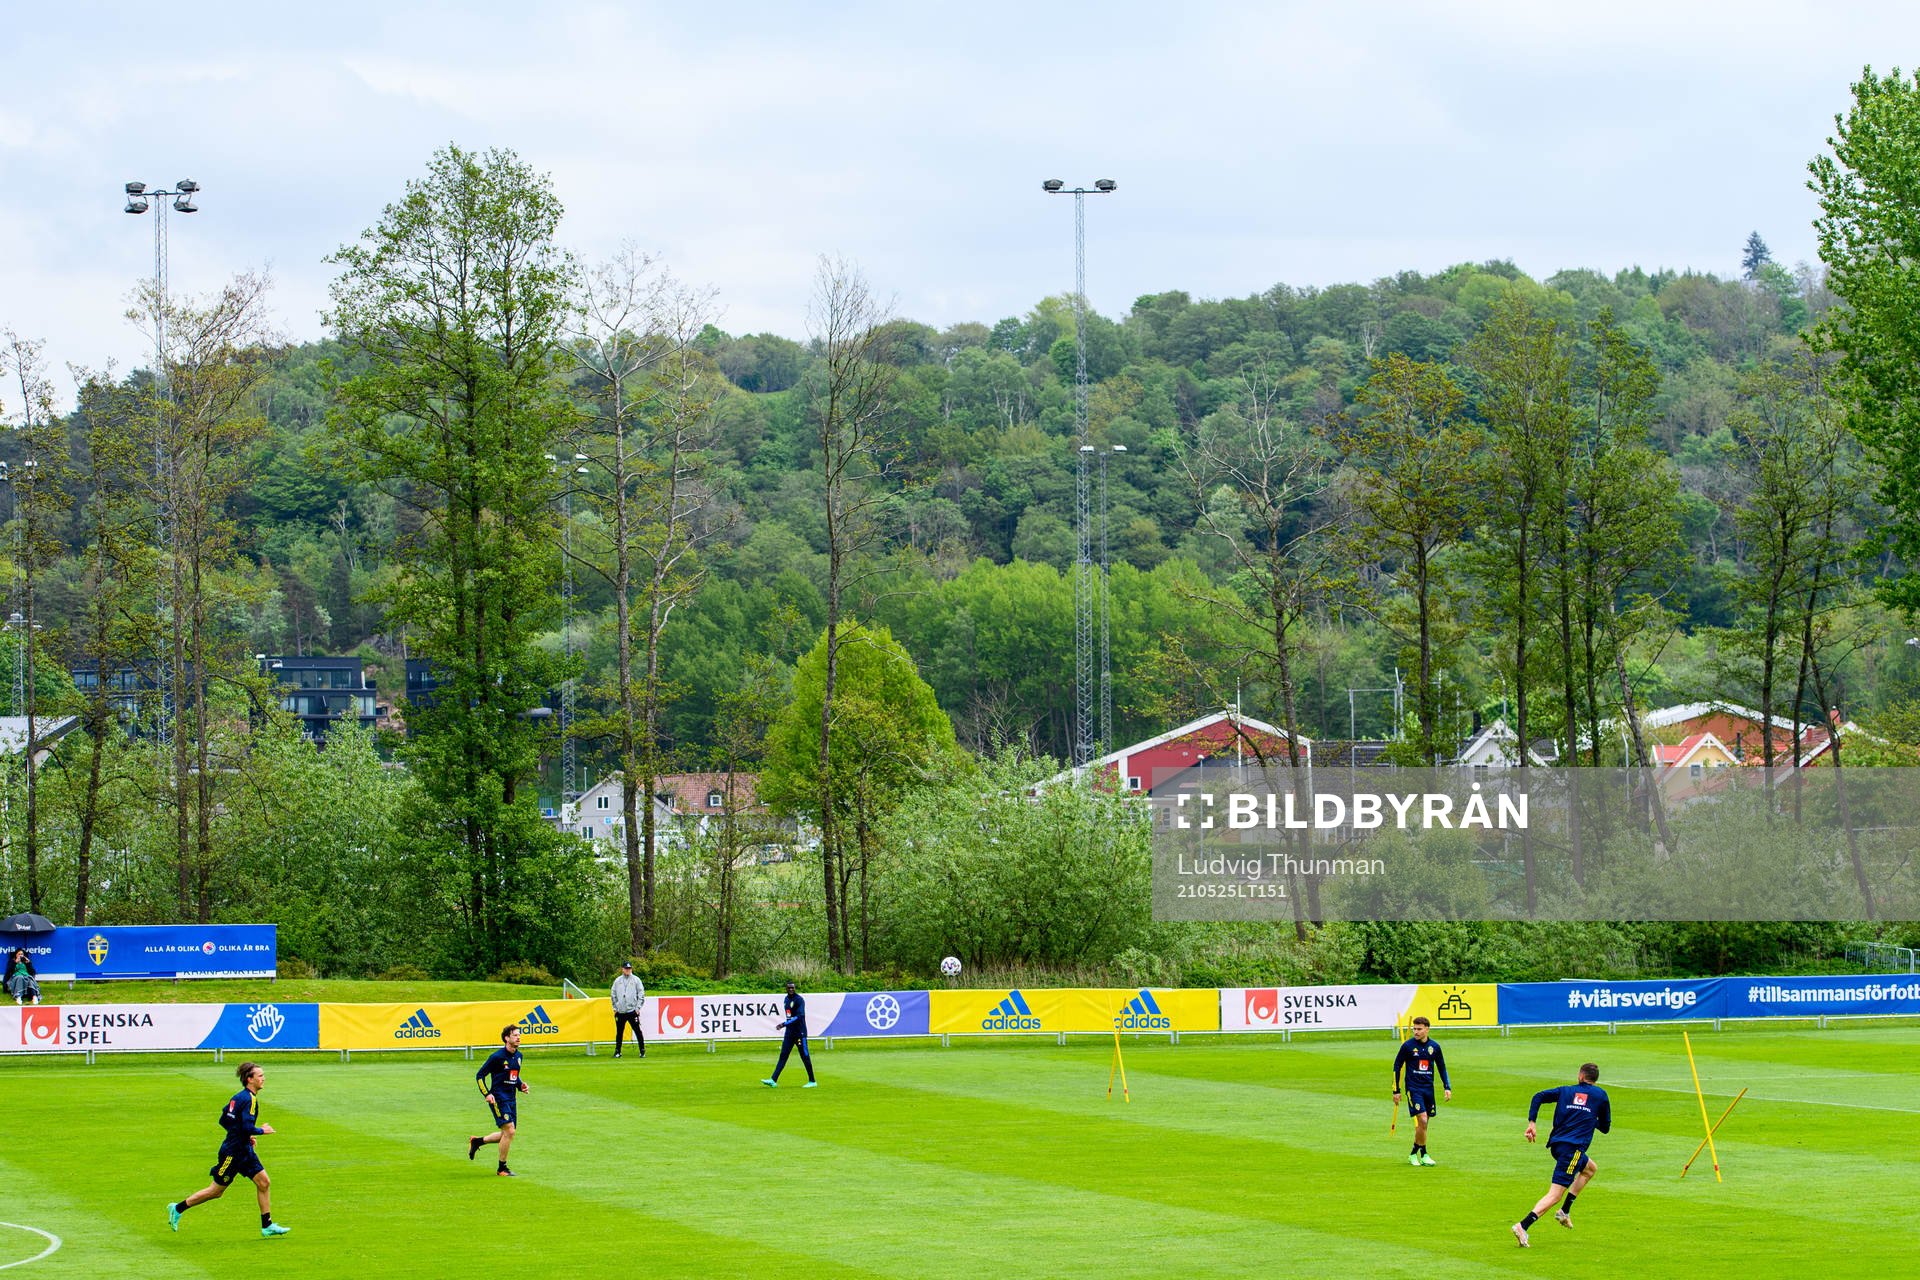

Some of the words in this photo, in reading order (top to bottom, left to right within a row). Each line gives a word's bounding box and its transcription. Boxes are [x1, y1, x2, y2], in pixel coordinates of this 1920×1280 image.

[165, 944, 176, 952] ÄR
[243, 944, 253, 952] ÄR
[255, 944, 270, 952] BRA
[1284, 994, 1358, 1009] SVENSKA
[1568, 987, 1697, 1010] #viärsverige
[700, 1003, 780, 1018] SVENSKA
[1284, 1010, 1323, 1024] SPEL
[67, 1013, 154, 1028] SVENSKA
[700, 1019, 742, 1034] SPEL
[981, 1015, 1041, 1030] adidas
[67, 1030, 112, 1045] SPEL
[394, 1027, 441, 1039] adidas
